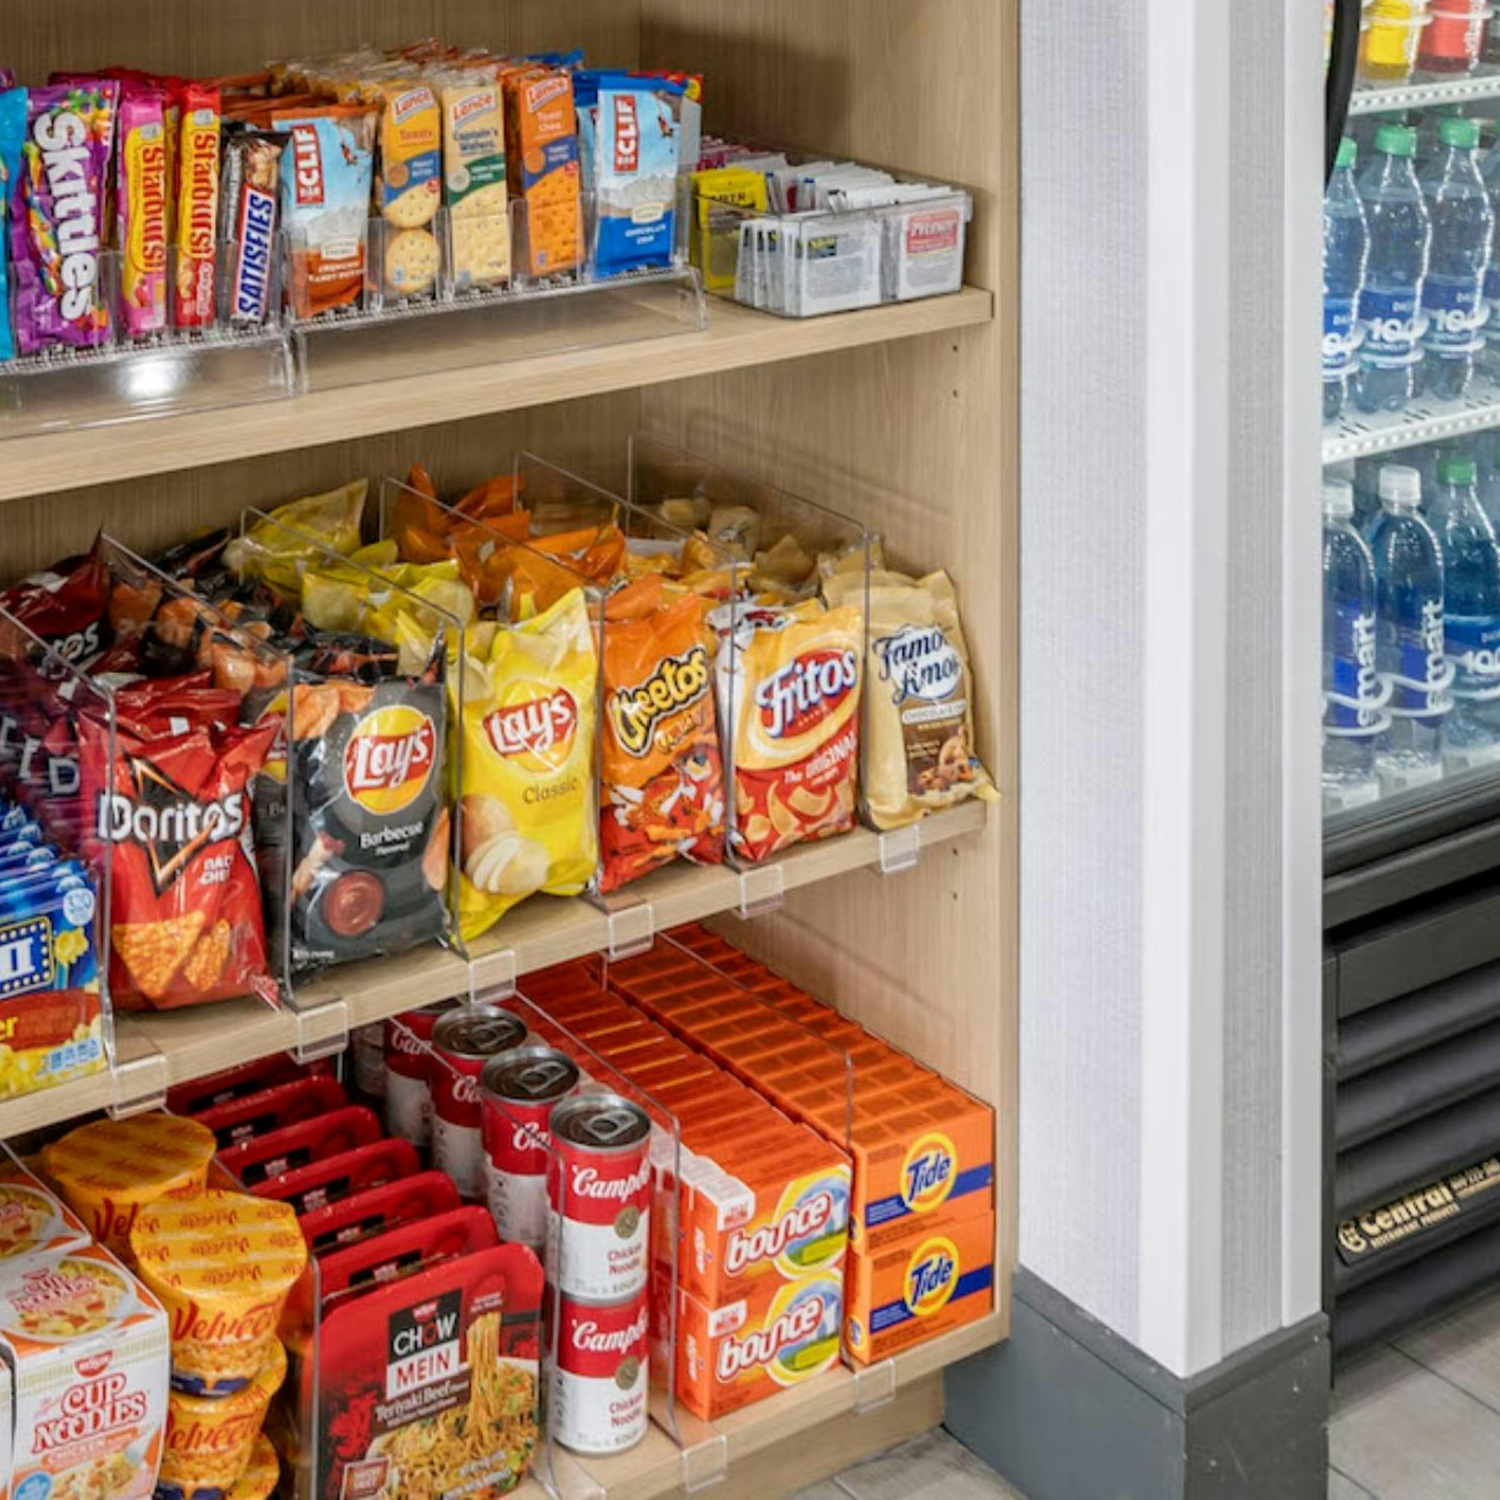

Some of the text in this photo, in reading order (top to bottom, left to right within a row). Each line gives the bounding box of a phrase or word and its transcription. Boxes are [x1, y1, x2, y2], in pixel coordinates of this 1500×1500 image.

[452, 94, 492, 119] Lance
[34, 111, 100, 321] Skittles
[141, 146, 166, 273] Starburst
[191, 132, 218, 258] Starburst
[238, 193, 274, 318] SATISFIES
[872, 625, 947, 681] Famo
[612, 646, 707, 753] Cheetos
[757, 650, 857, 738] Fritos
[491, 693, 573, 755] Lay's
[353, 729, 430, 789] Lay's
[100, 792, 244, 846] Doritos
[522, 779, 579, 805] Classic
[360, 822, 424, 849] Barbecue
[905, 1152, 951, 1203] Tide
[726, 1192, 831, 1274] bounce
[1359, 1181, 1454, 1236] Central
[910, 1256, 954, 1306] Tide
[393, 1312, 456, 1356] CHOW
[718, 1296, 824, 1382] bounce
[61, 1372, 127, 1417] CUP
[396, 1349, 450, 1388] MEIN
[424, 1381, 450, 1400] Beef
[32, 1392, 147, 1455] NOODLES
